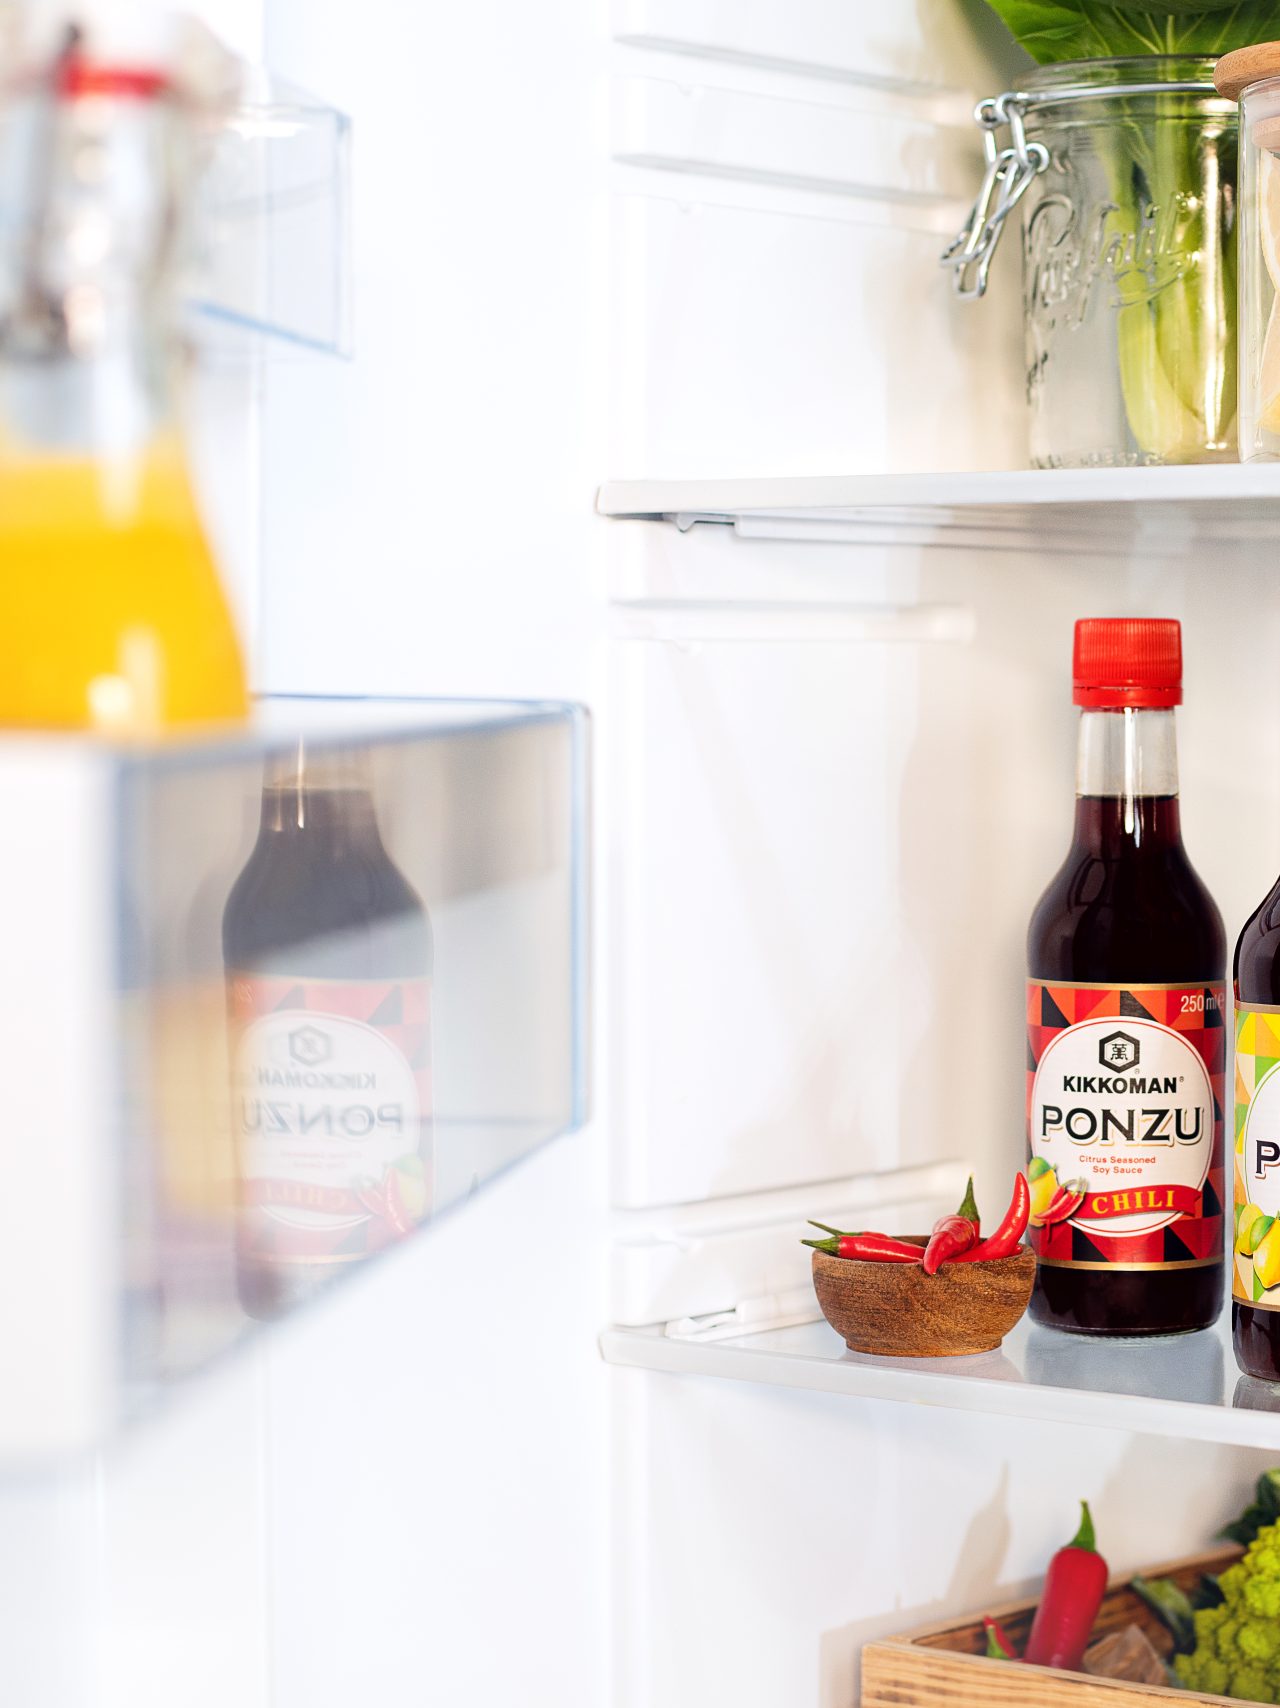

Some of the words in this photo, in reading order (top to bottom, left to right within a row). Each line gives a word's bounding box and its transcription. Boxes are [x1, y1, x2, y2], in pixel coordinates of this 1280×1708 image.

[1181, 995, 1204, 1012] 250
[1063, 1075, 1177, 1094] KIKKOMAN
[1041, 1104, 1204, 1144] PONZU
[1079, 1155, 1107, 1164] Citrus
[1110, 1156, 1156, 1164] Seasoned
[1092, 1166, 1110, 1175] Soy
[1112, 1166, 1143, 1174] Sauce
[1092, 1190, 1175, 1214] CHILI
